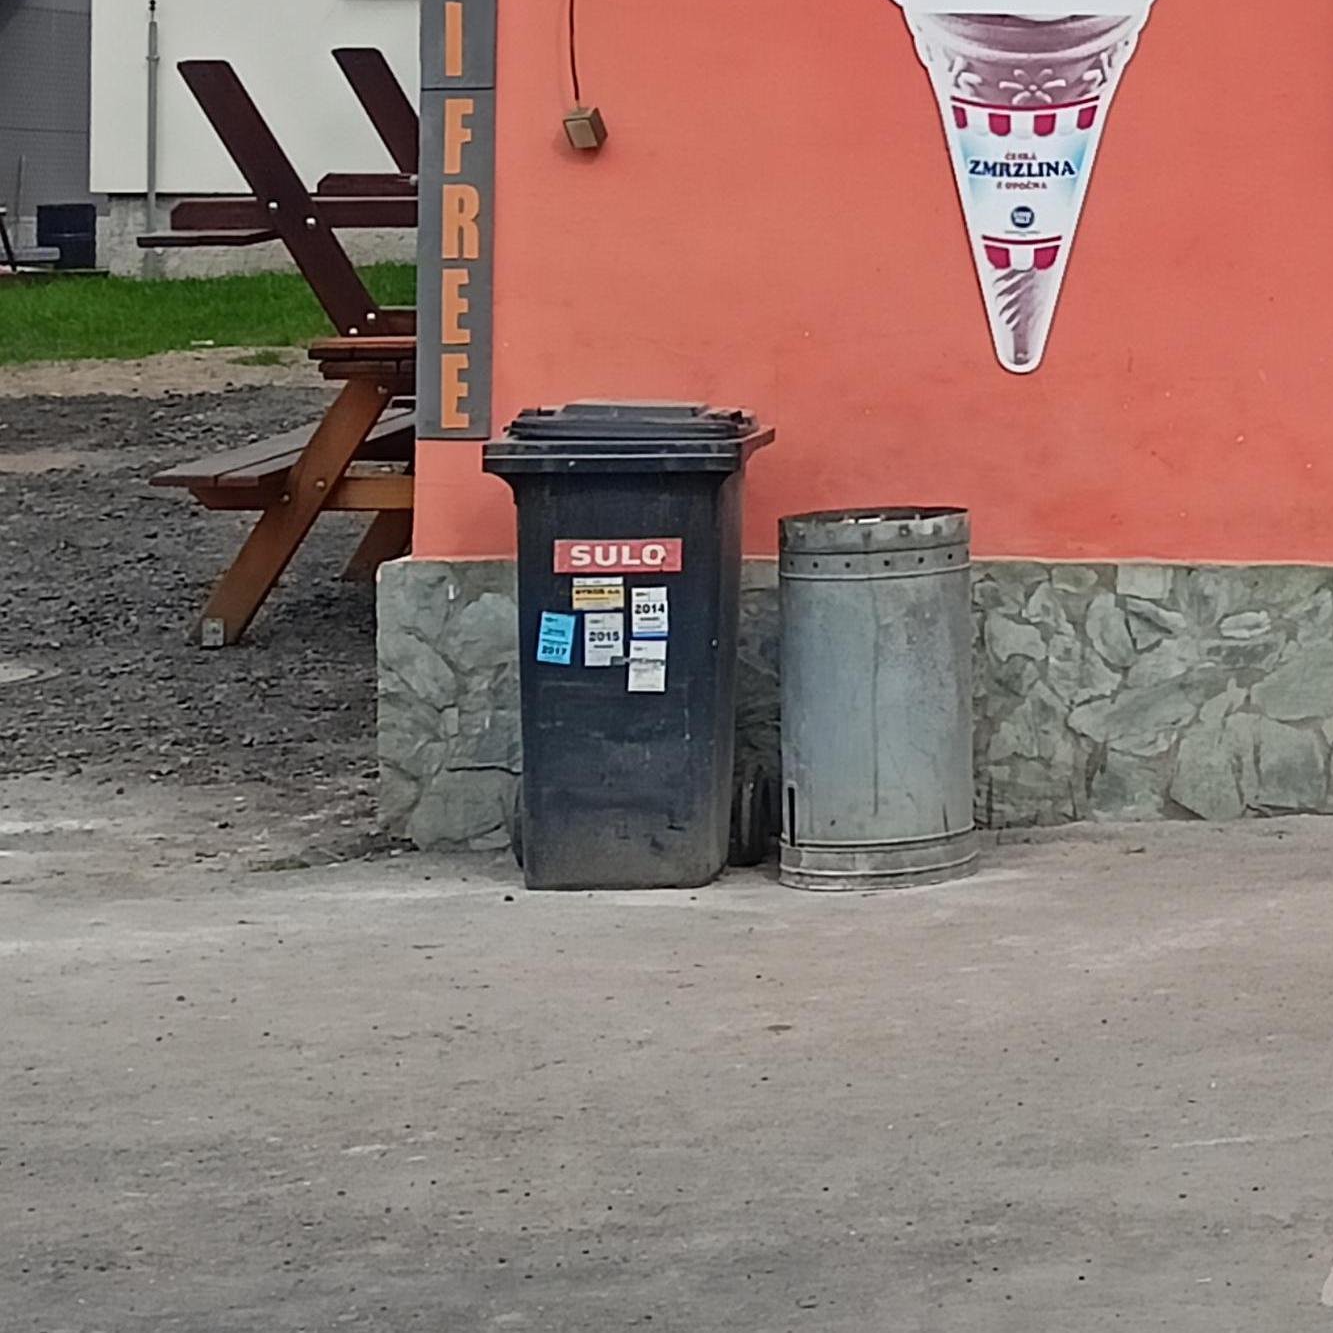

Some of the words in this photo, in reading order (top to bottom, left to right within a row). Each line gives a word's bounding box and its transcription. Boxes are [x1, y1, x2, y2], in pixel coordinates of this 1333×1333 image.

[968, 159, 1076, 178] ZMRZLINA
[441, 98, 479, 429] FREE
[570, 544, 667, 566] SULO
[634, 603, 666, 615] 2014
[588, 630, 621, 643] 2015
